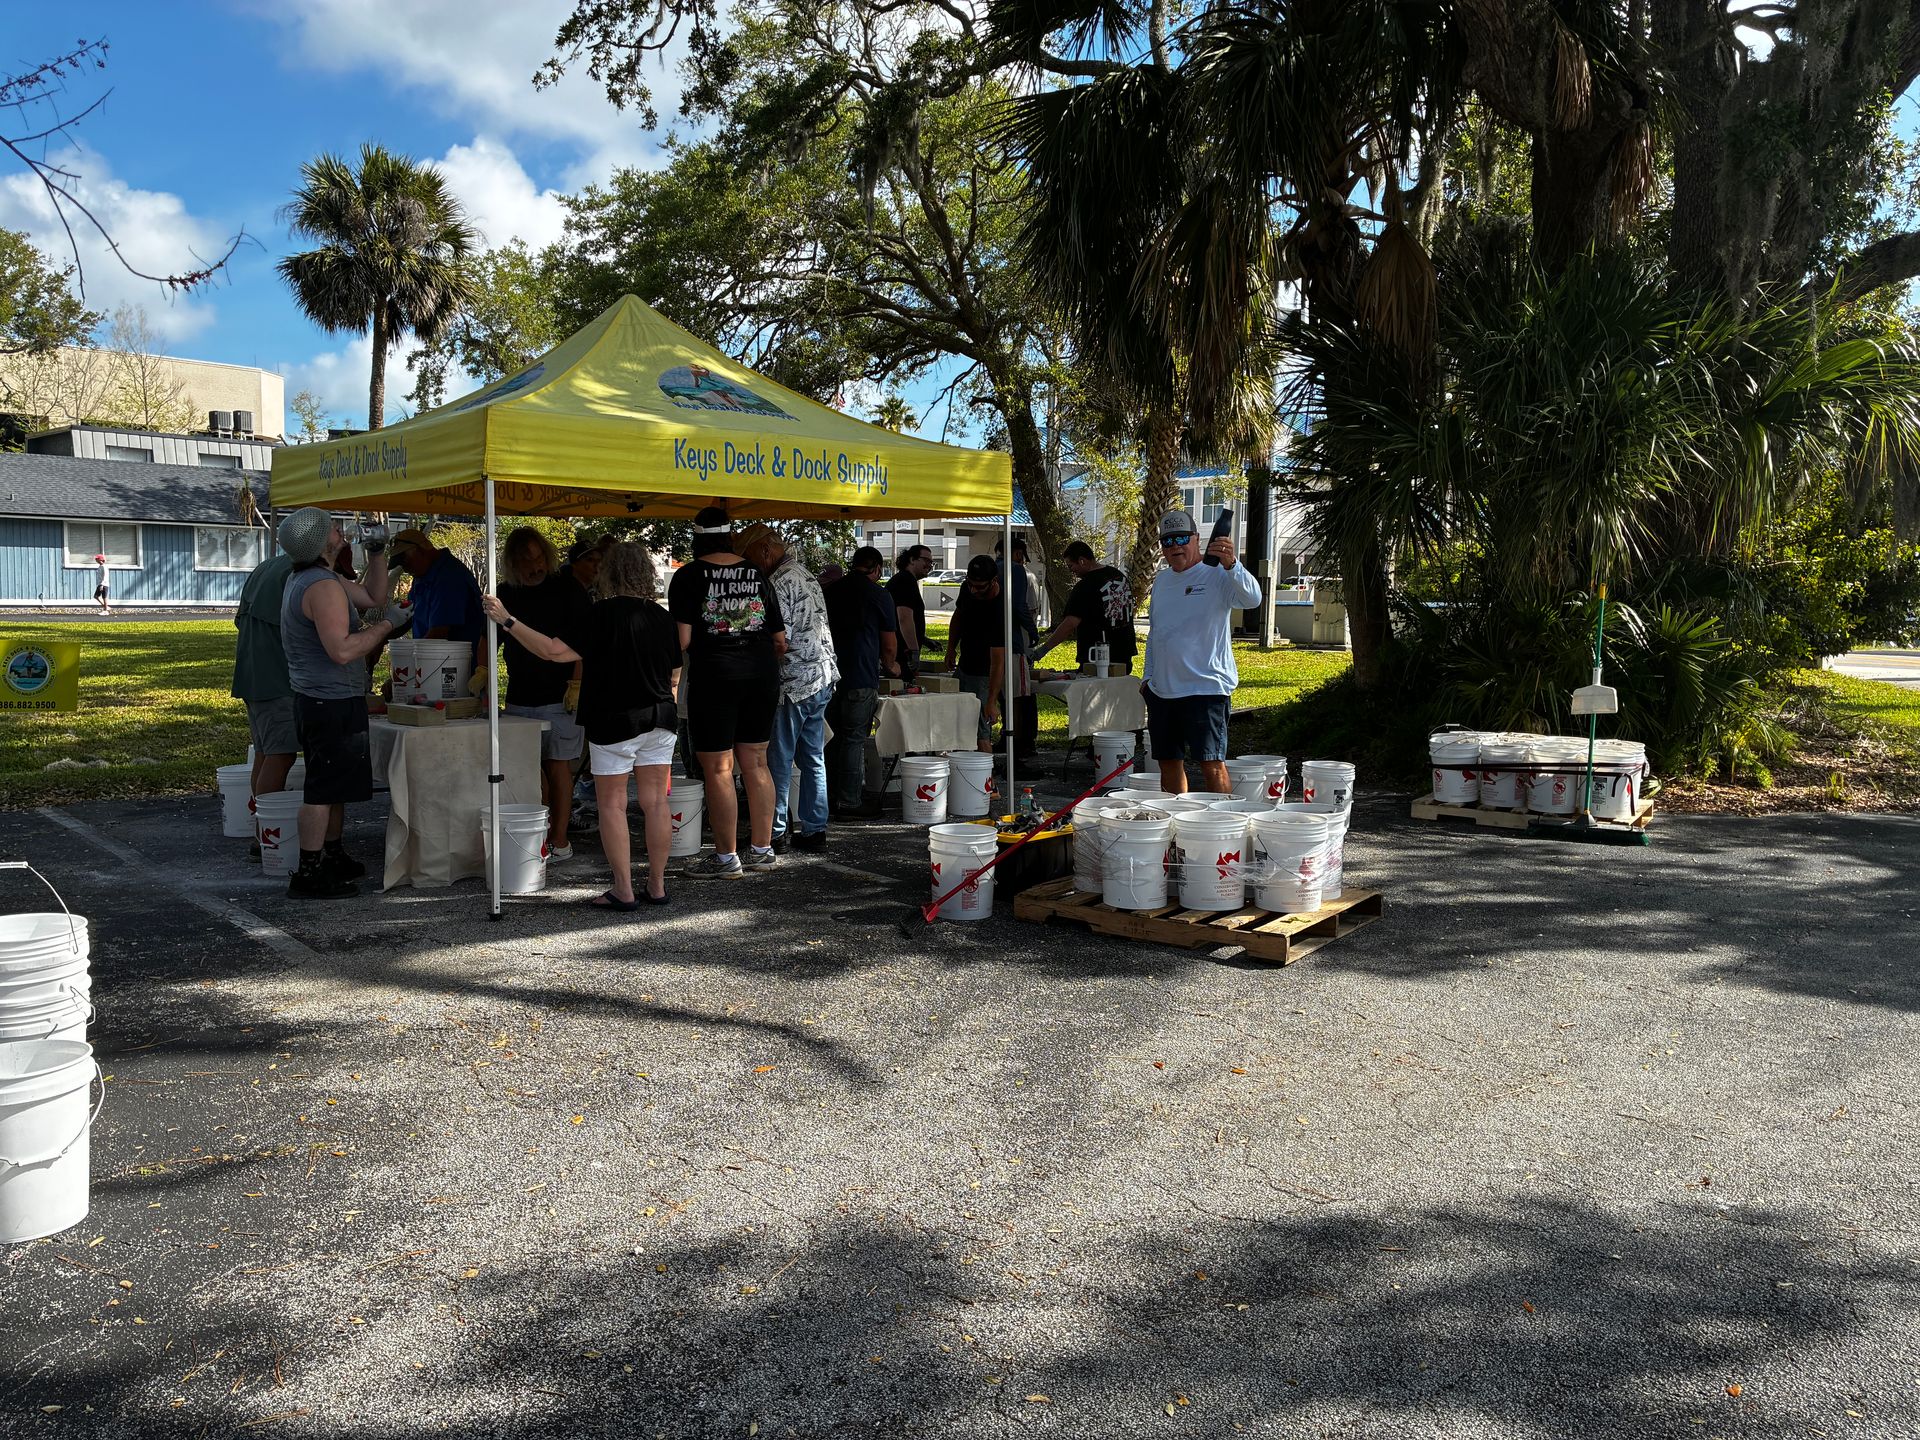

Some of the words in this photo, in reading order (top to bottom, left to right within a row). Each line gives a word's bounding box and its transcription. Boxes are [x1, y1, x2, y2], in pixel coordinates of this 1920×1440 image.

[319, 451, 334, 488] Keys
[336, 445, 352, 479] Deck
[354, 445, 361, 476] &
[362, 439, 380, 475] Dock
[382, 435, 408, 480] Supply
[674, 438, 718, 481] Keys
[724, 441, 766, 475] Deck
[772, 445, 787, 478] &
[793, 448, 832, 481] Dock
[837, 453, 888, 495] Supply
[704, 569, 708, 578] I
[712, 567, 745, 580] WANT
[747, 568, 758, 580] IT
[708, 582, 726, 597] ALL
[729, 581, 761, 595] RIGHT
[721, 597, 749, 611] NOW
